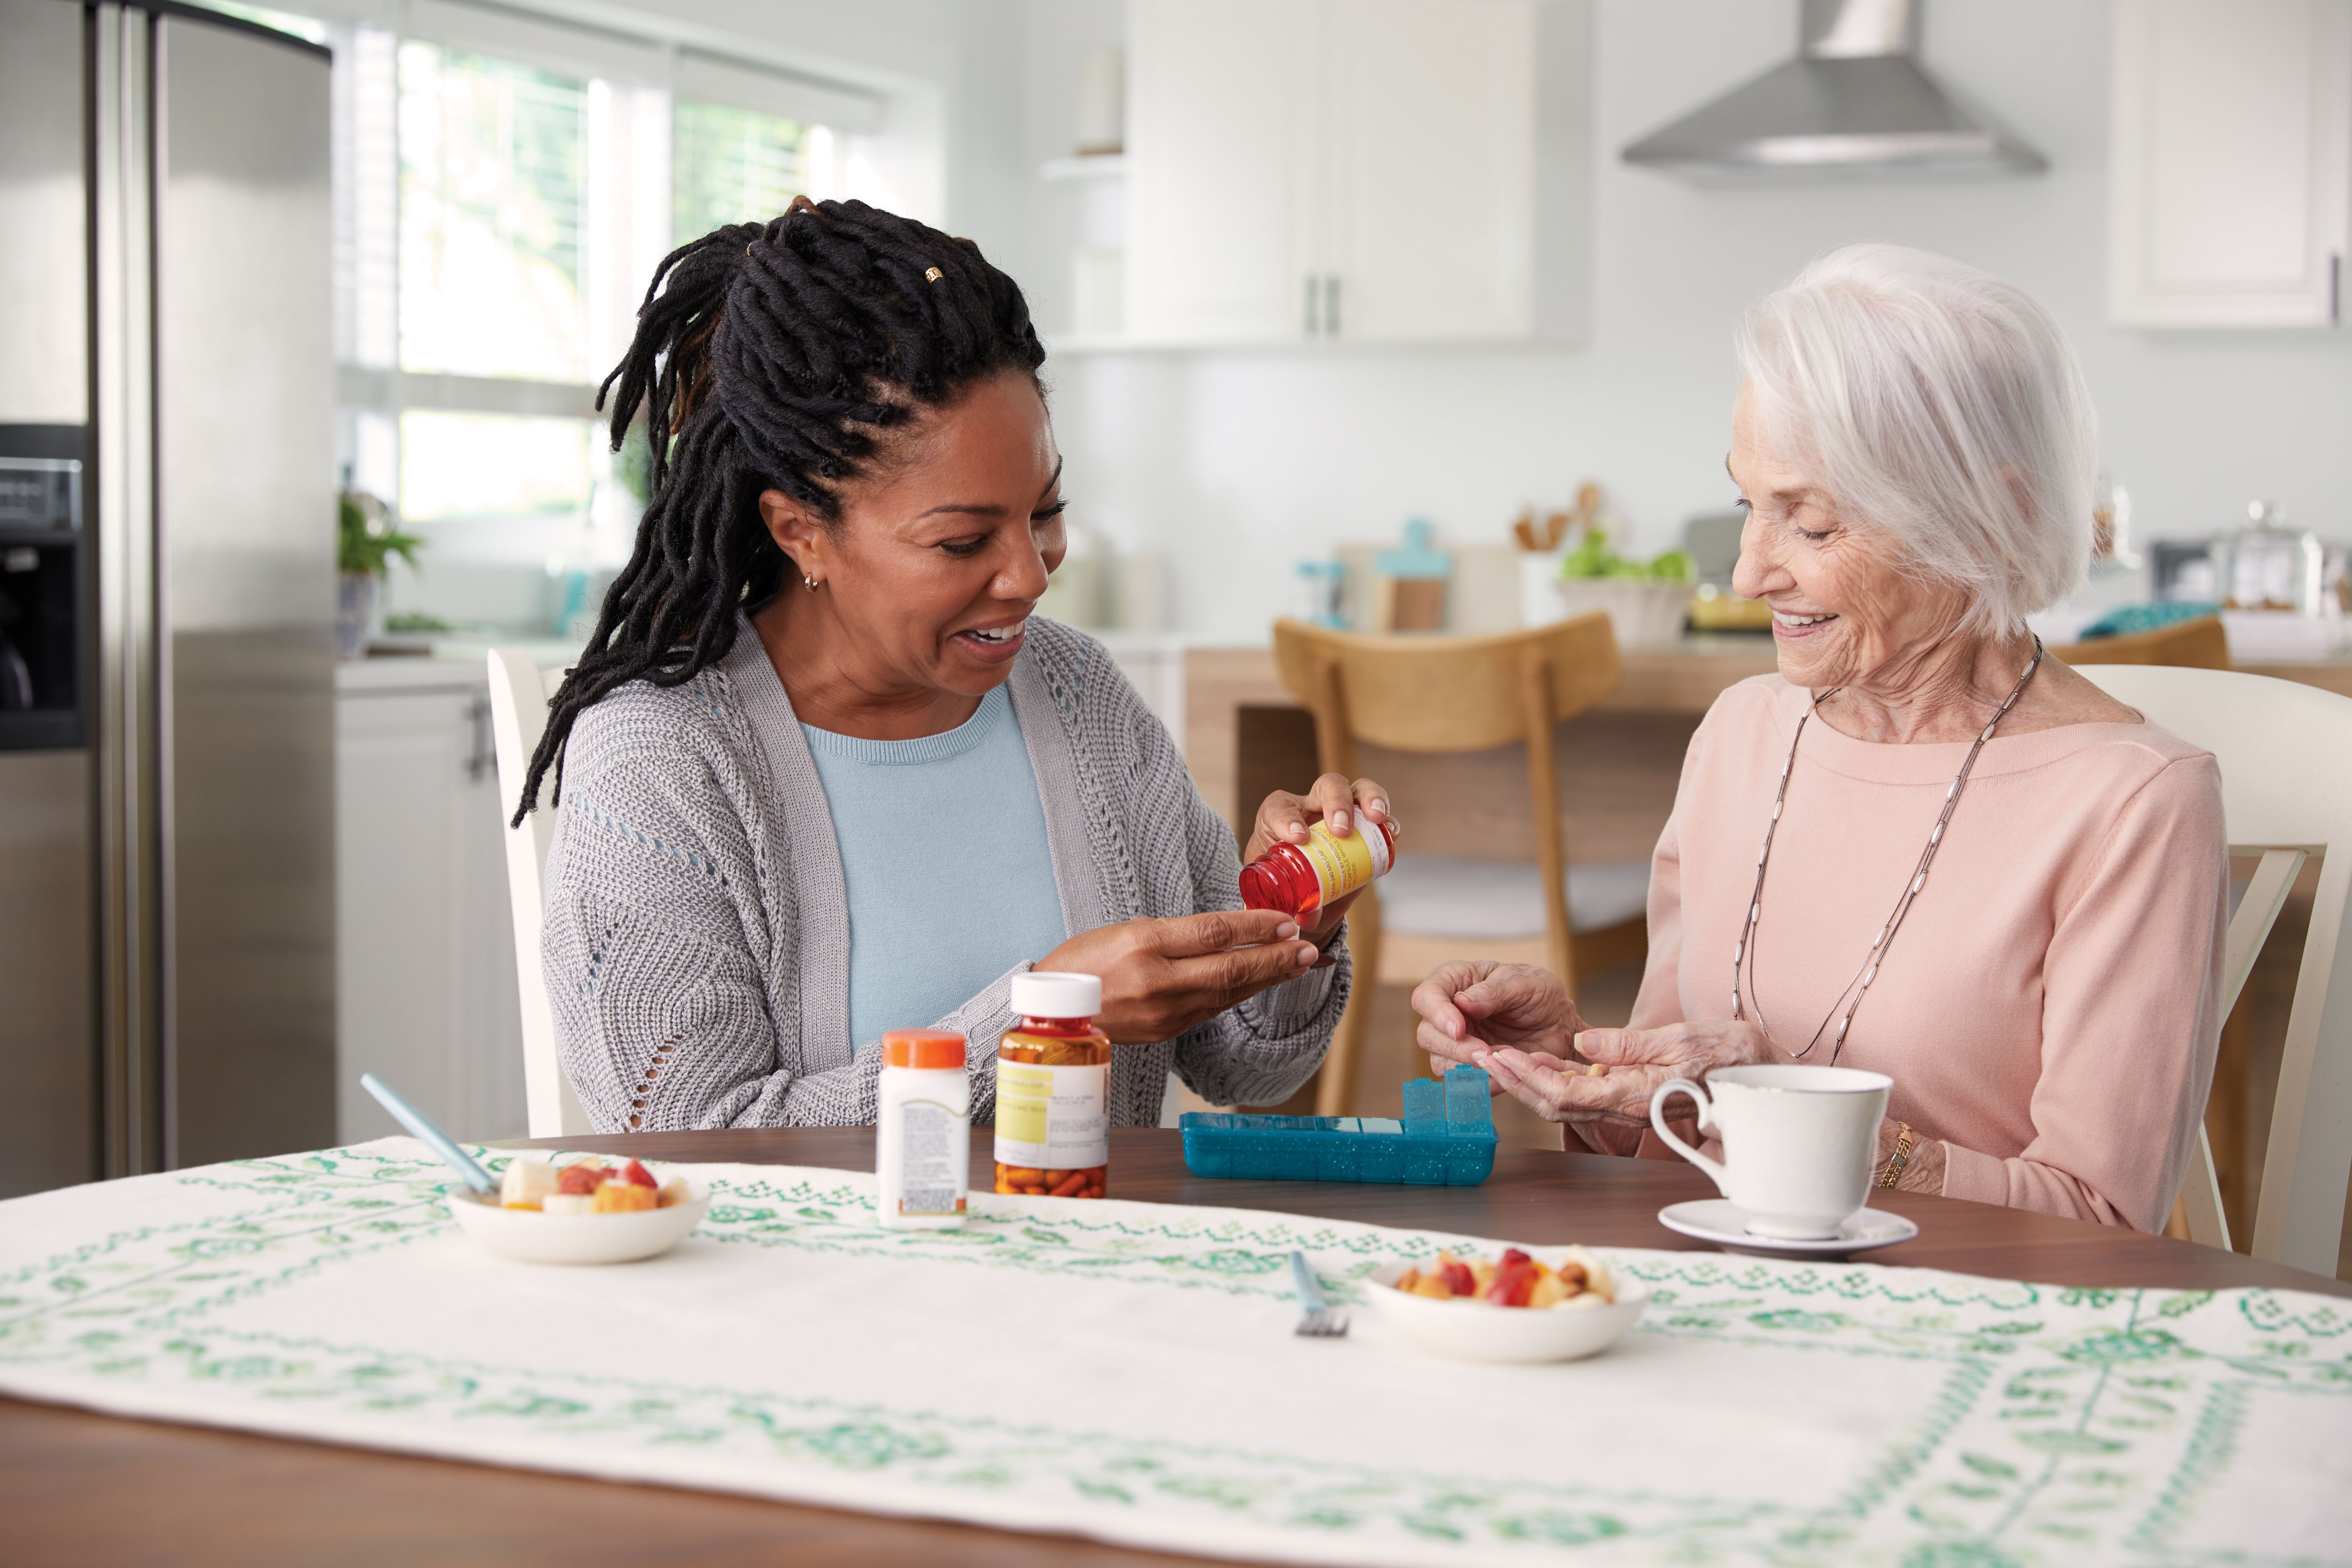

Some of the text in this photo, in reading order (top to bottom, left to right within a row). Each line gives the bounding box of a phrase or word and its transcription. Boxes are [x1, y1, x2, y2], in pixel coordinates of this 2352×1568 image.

[1318, 850, 1327, 860] CAP
[1328, 843, 1341, 861] MOUTH
[1333, 839, 1346, 858] WHOLE.
[1325, 861, 1332, 871] MG
